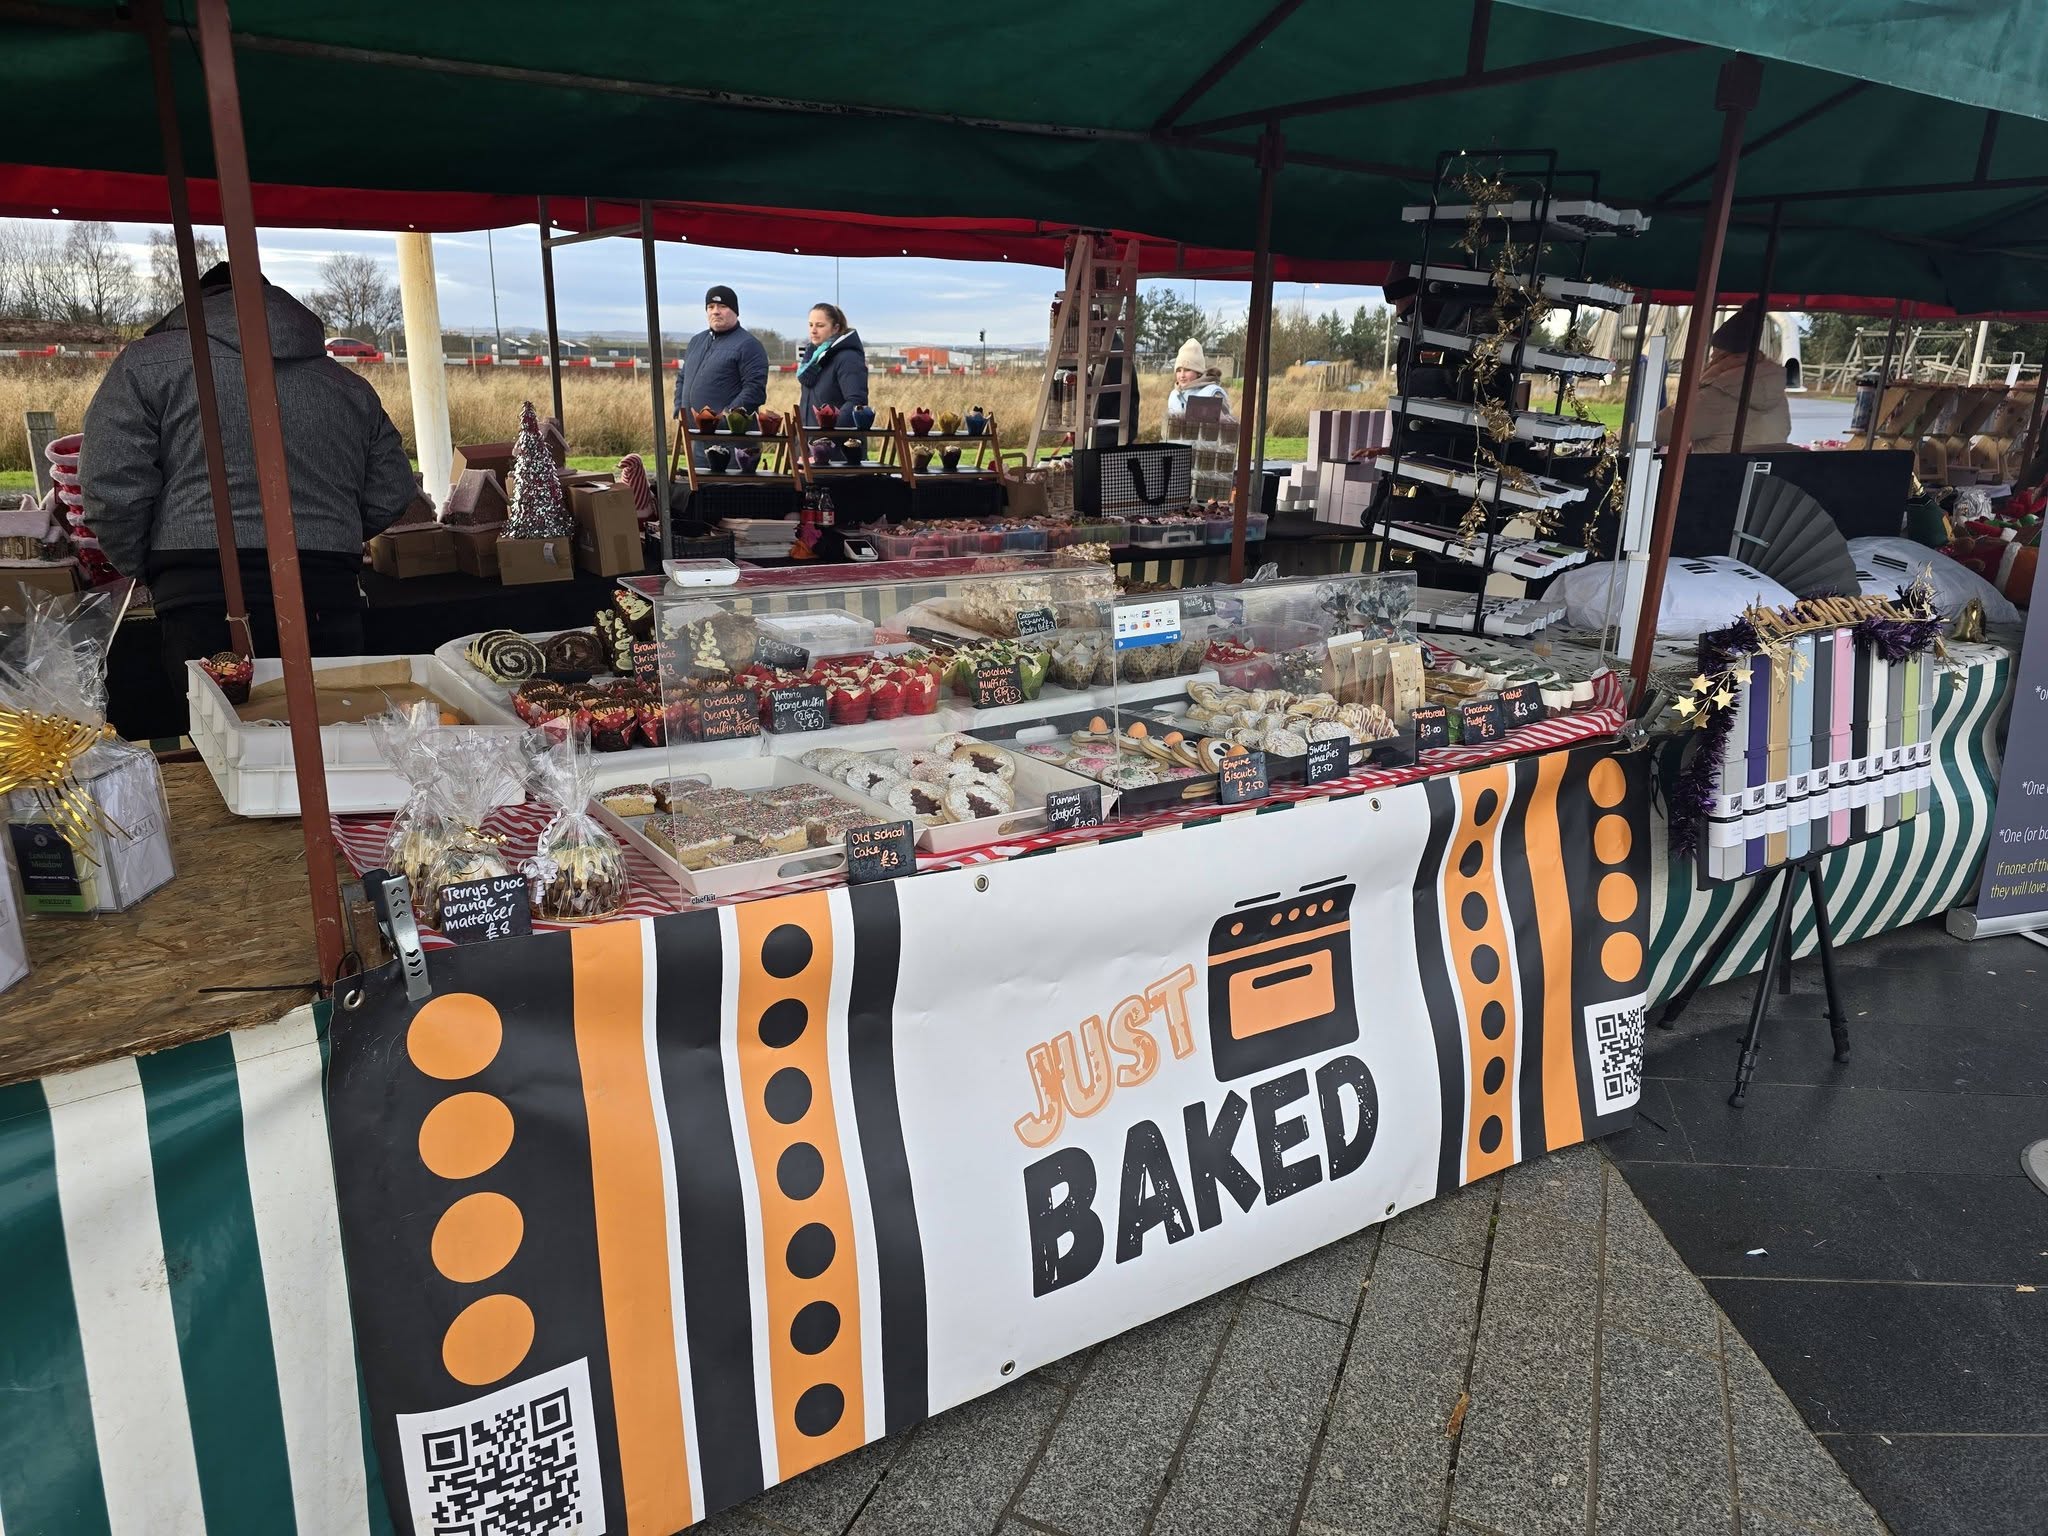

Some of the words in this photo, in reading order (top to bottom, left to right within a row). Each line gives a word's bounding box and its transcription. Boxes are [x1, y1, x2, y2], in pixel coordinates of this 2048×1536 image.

[977, 667, 1014, 679] Chocolate
[704, 693, 746, 708] Chocolate
[1500, 688, 1524, 701] Tablet
[1309, 740, 1331, 756] Sweet
[1222, 757, 1251, 770] Empire
[1224, 768, 1257, 782] Biscuits
[1049, 793, 1081, 807] Jammy
[851, 831, 871, 845] Old
[853, 845, 881, 859] Cake
[880, 849, 899, 867] £3
[2003, 862, 2027, 876] none
[2027, 858, 2039, 874] of
[443, 883, 489, 902] Terrys
[500, 893, 513, 901] +
[1990, 884, 2010, 900] they
[2011, 881, 2028, 896] will
[2028, 880, 2046, 894] love
[485, 920, 511, 940] £8
[1013, 963, 1198, 1148] JUST
[1023, 1054, 1379, 1298] BAKED
